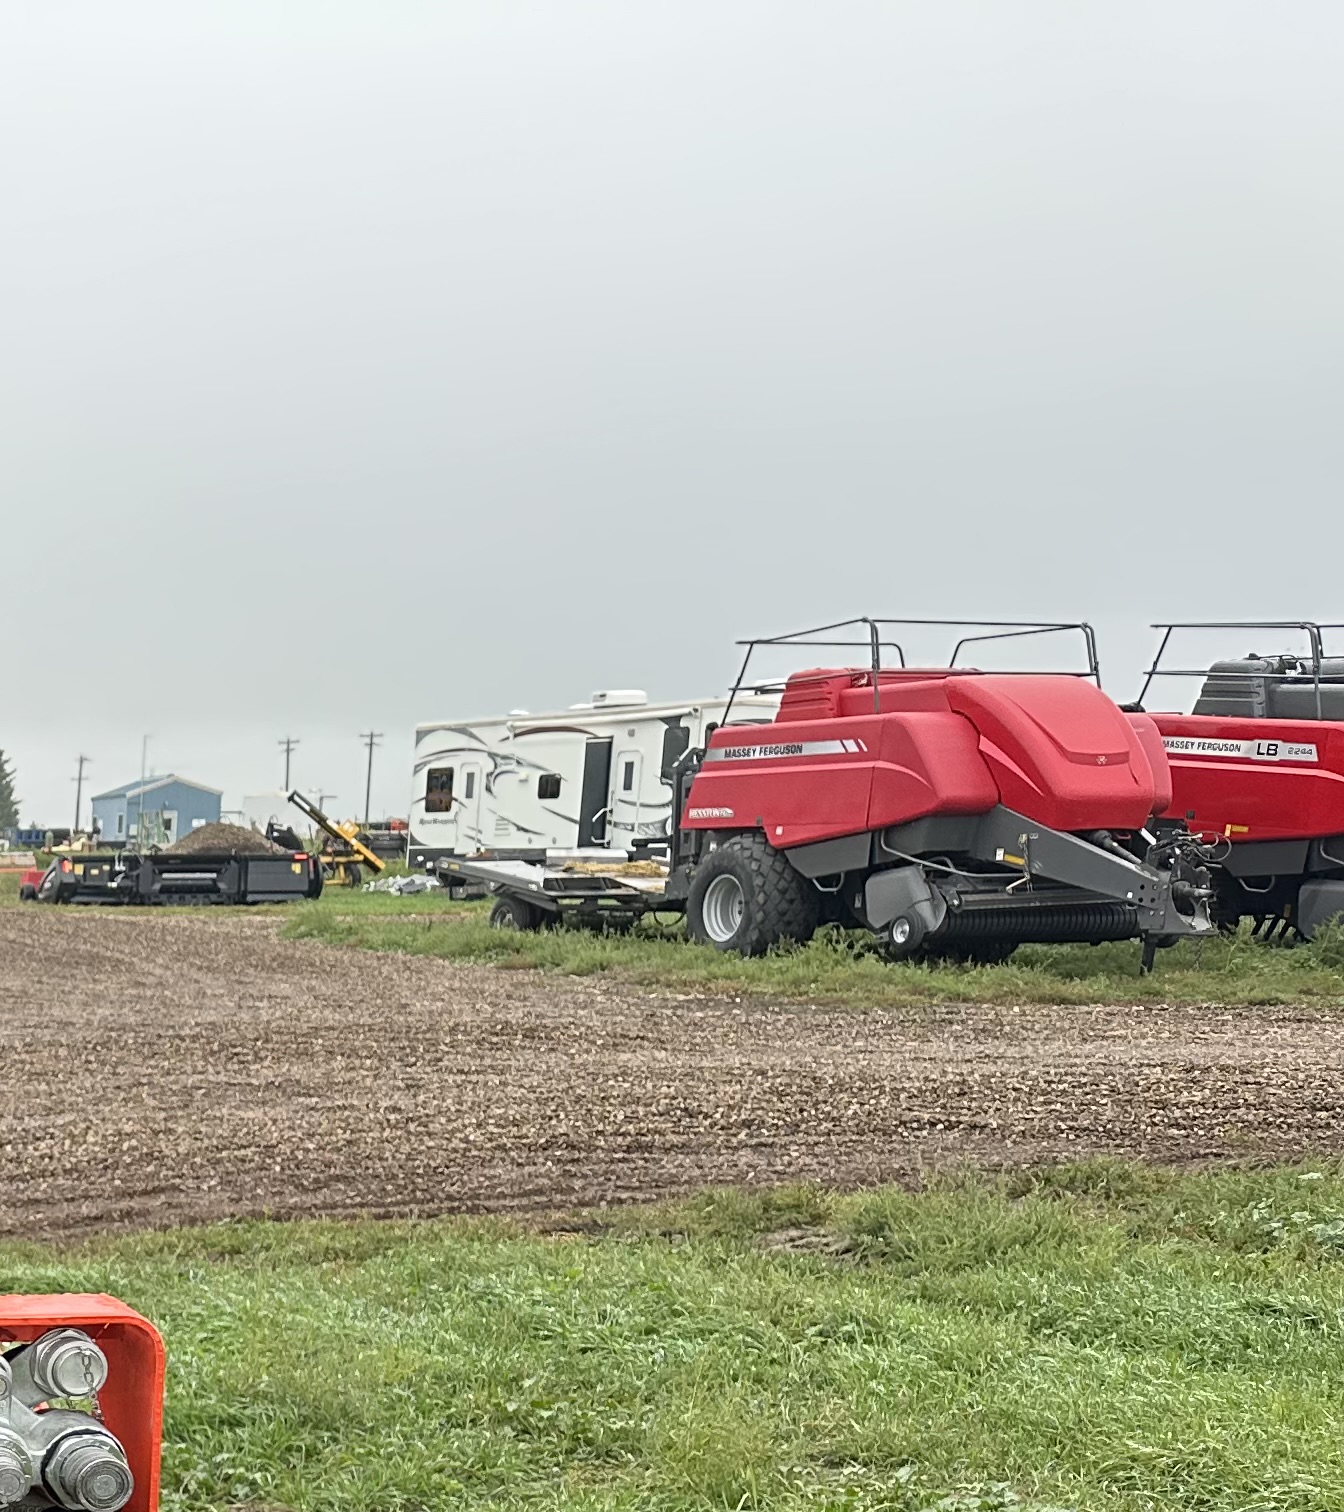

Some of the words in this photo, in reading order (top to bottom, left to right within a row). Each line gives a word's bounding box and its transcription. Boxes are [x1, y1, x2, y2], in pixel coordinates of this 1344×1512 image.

[724, 748, 757, 759] MASSEY
[758, 743, 804, 756] FERGUSON
[1163, 740, 1195, 751] MASSEY
[1196, 741, 1242, 753] FERGUSON
[1256, 742, 1279, 757] LB
